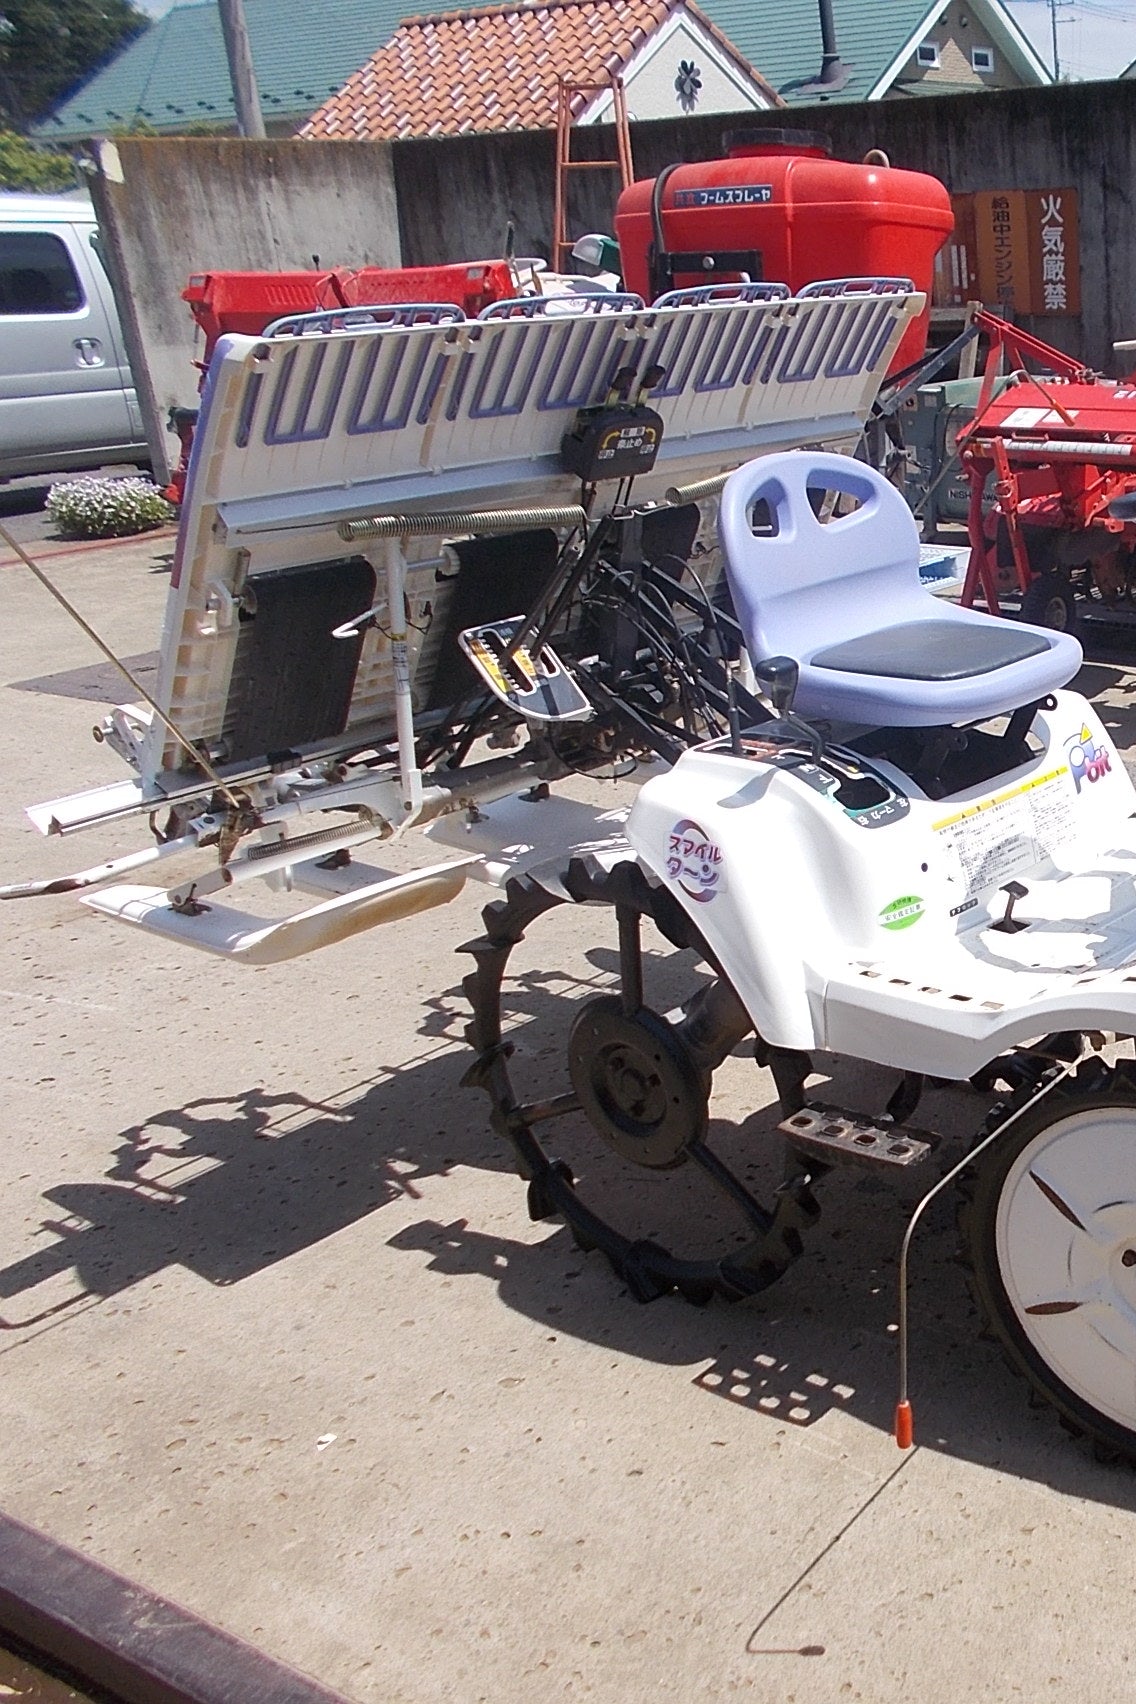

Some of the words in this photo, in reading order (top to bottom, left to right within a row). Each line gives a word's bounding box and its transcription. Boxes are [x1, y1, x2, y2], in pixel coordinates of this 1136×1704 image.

[1040, 194, 1067, 310] 火気厳禁
[669, 835, 722, 863] スマイル
